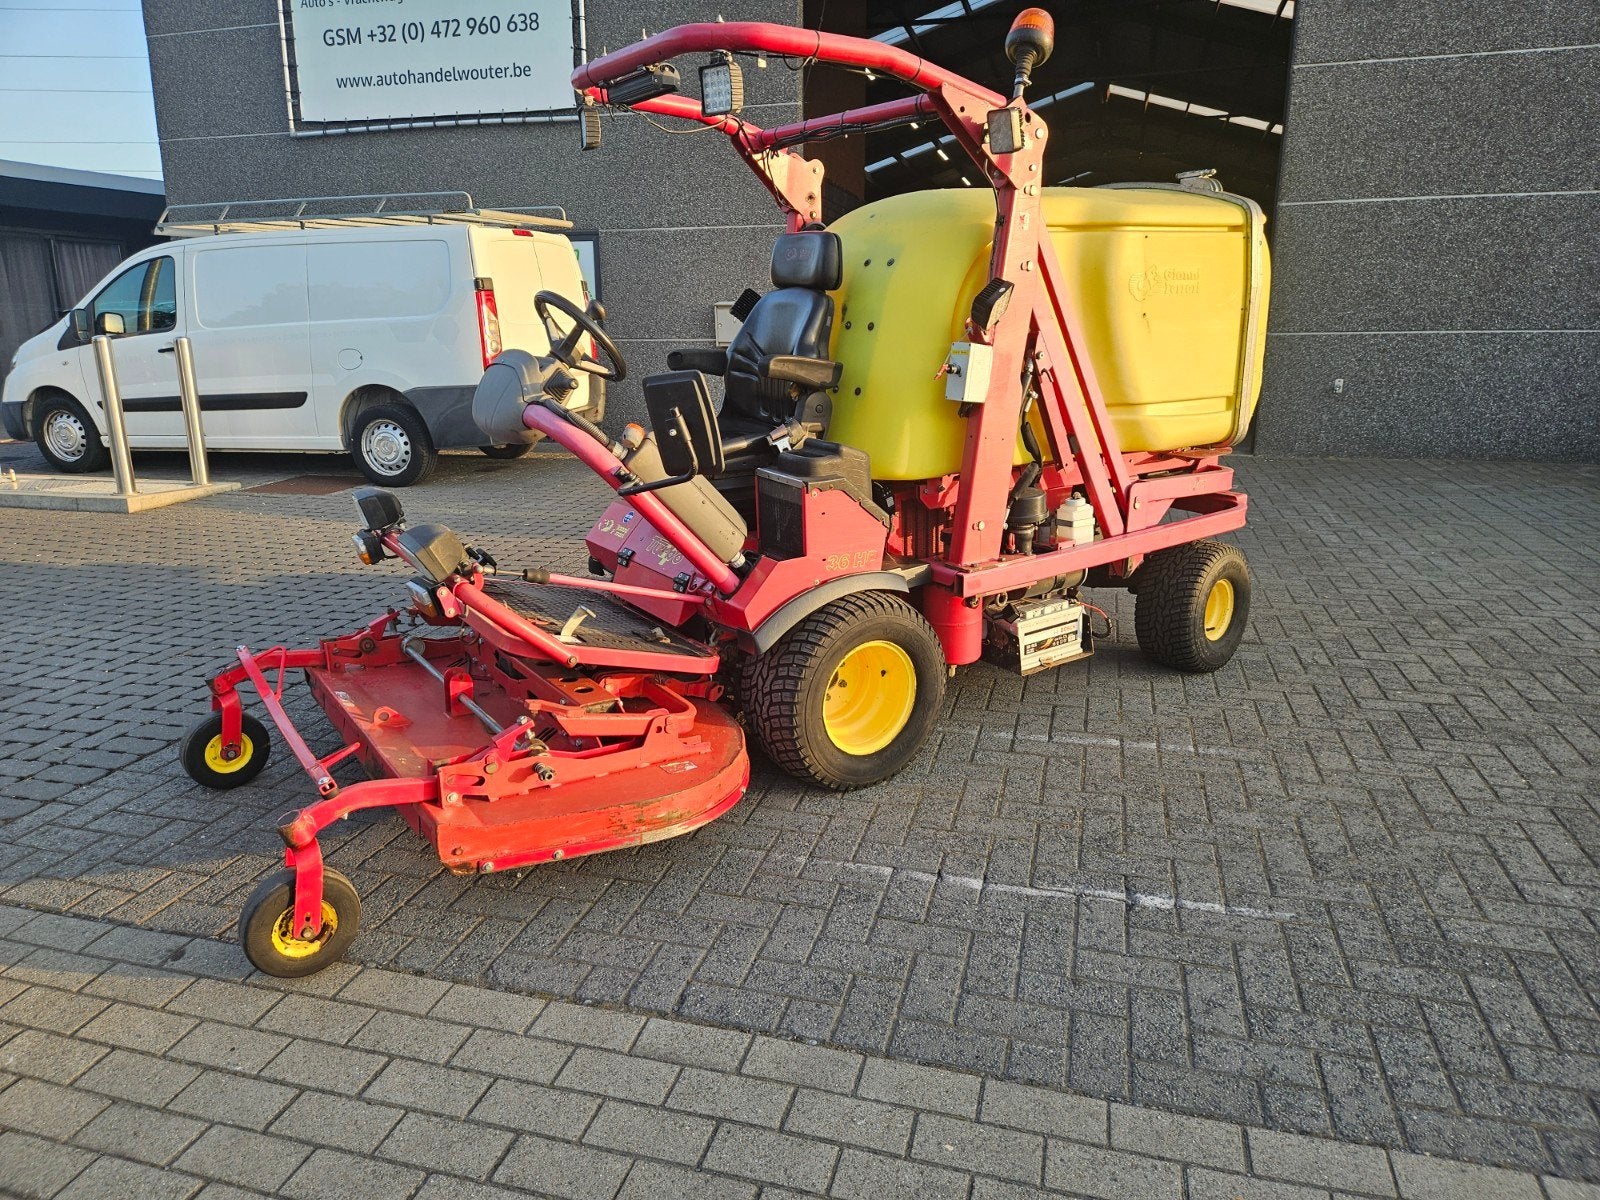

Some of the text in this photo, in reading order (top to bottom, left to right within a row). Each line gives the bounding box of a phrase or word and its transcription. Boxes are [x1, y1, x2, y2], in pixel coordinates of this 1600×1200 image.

[300, 0, 334, 8] Autos
[323, 12, 540, 47] GSM +32 (0) 472 960 638
[336, 62, 532, 89] www.autohandelwouter.be
[826, 553, 850, 570] 36
